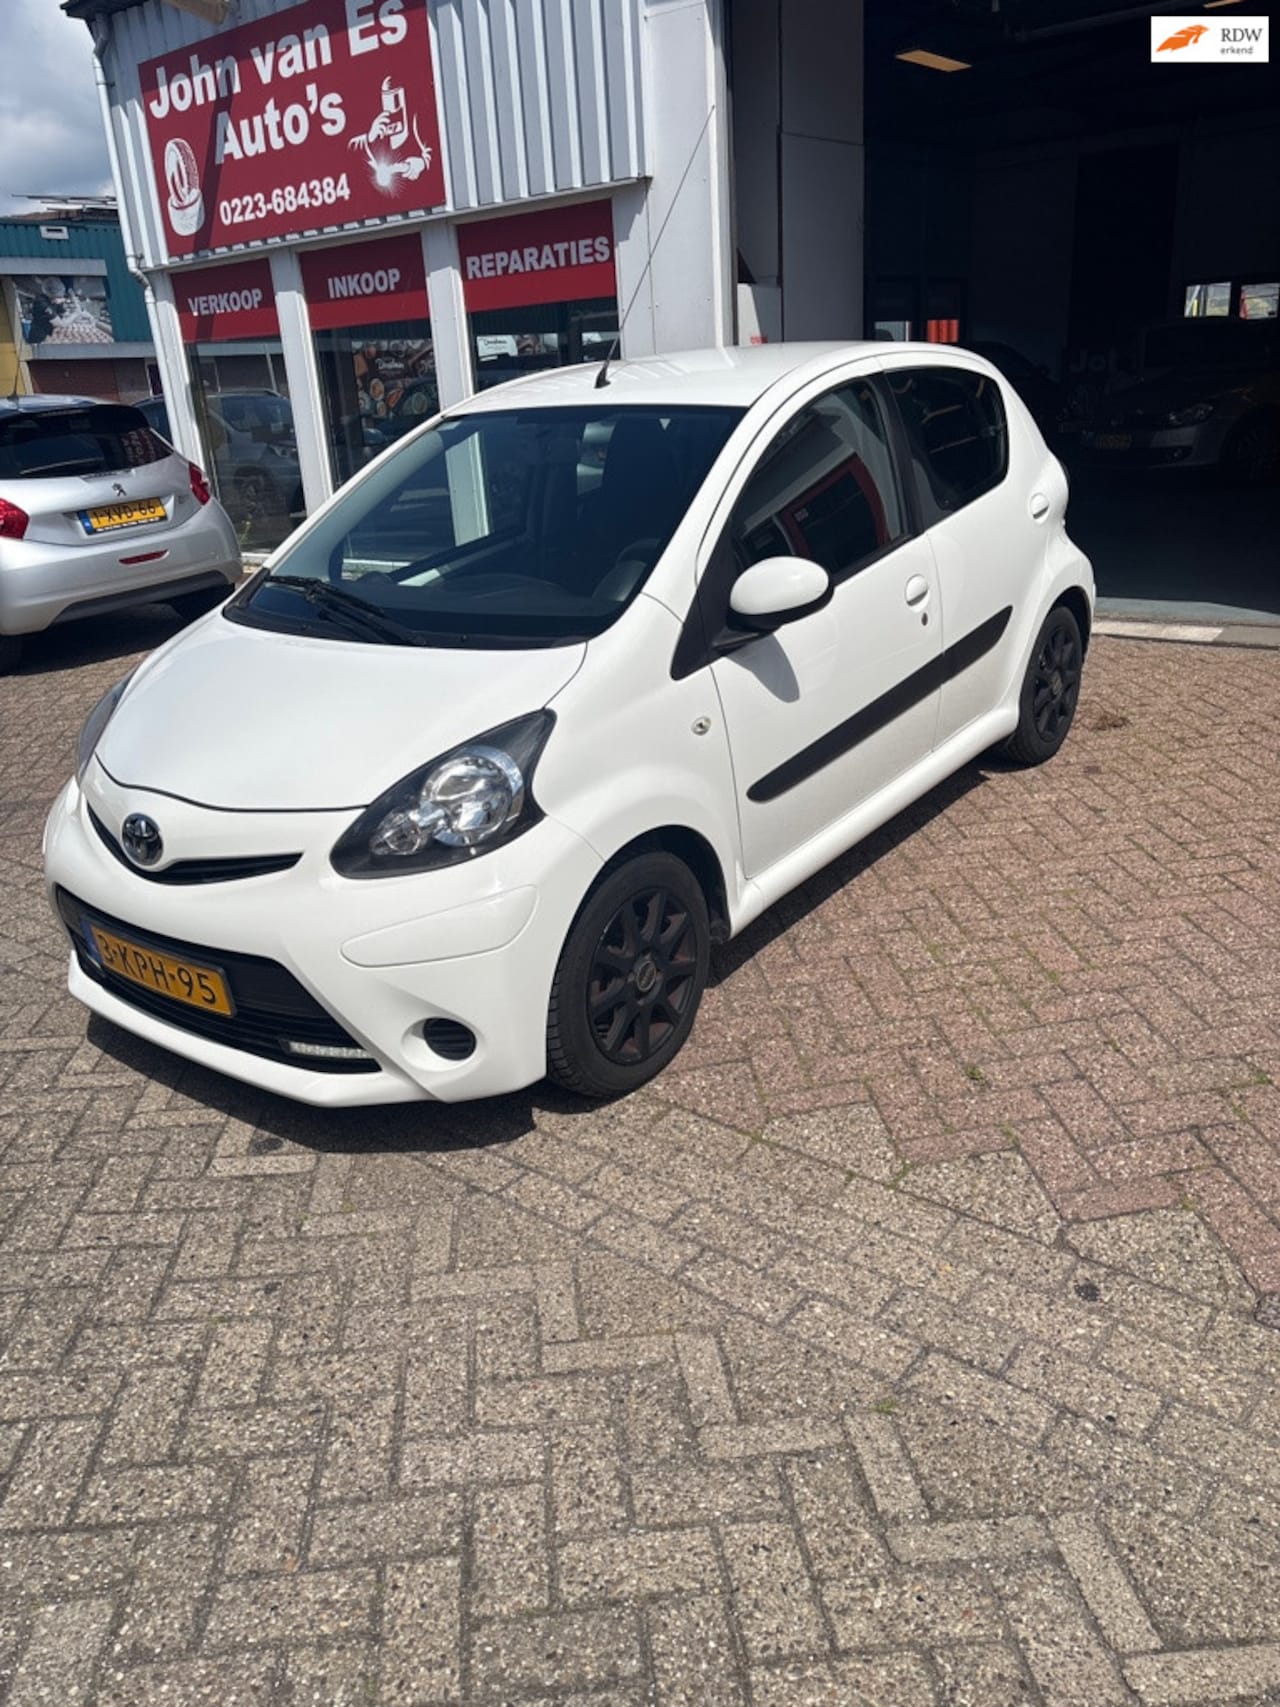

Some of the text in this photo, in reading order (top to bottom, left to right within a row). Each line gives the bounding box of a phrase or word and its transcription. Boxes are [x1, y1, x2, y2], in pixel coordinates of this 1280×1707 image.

[149, 0, 409, 119] John van Es
[214, 82, 347, 165] Auto's
[219, 172, 351, 226] 0223-684384
[327, 268, 401, 299] INKOOP
[466, 236, 610, 281] REPARATIES
[187, 288, 263, 317] VERKOOP
[97, 934, 217, 1005] 3-KPH-95
